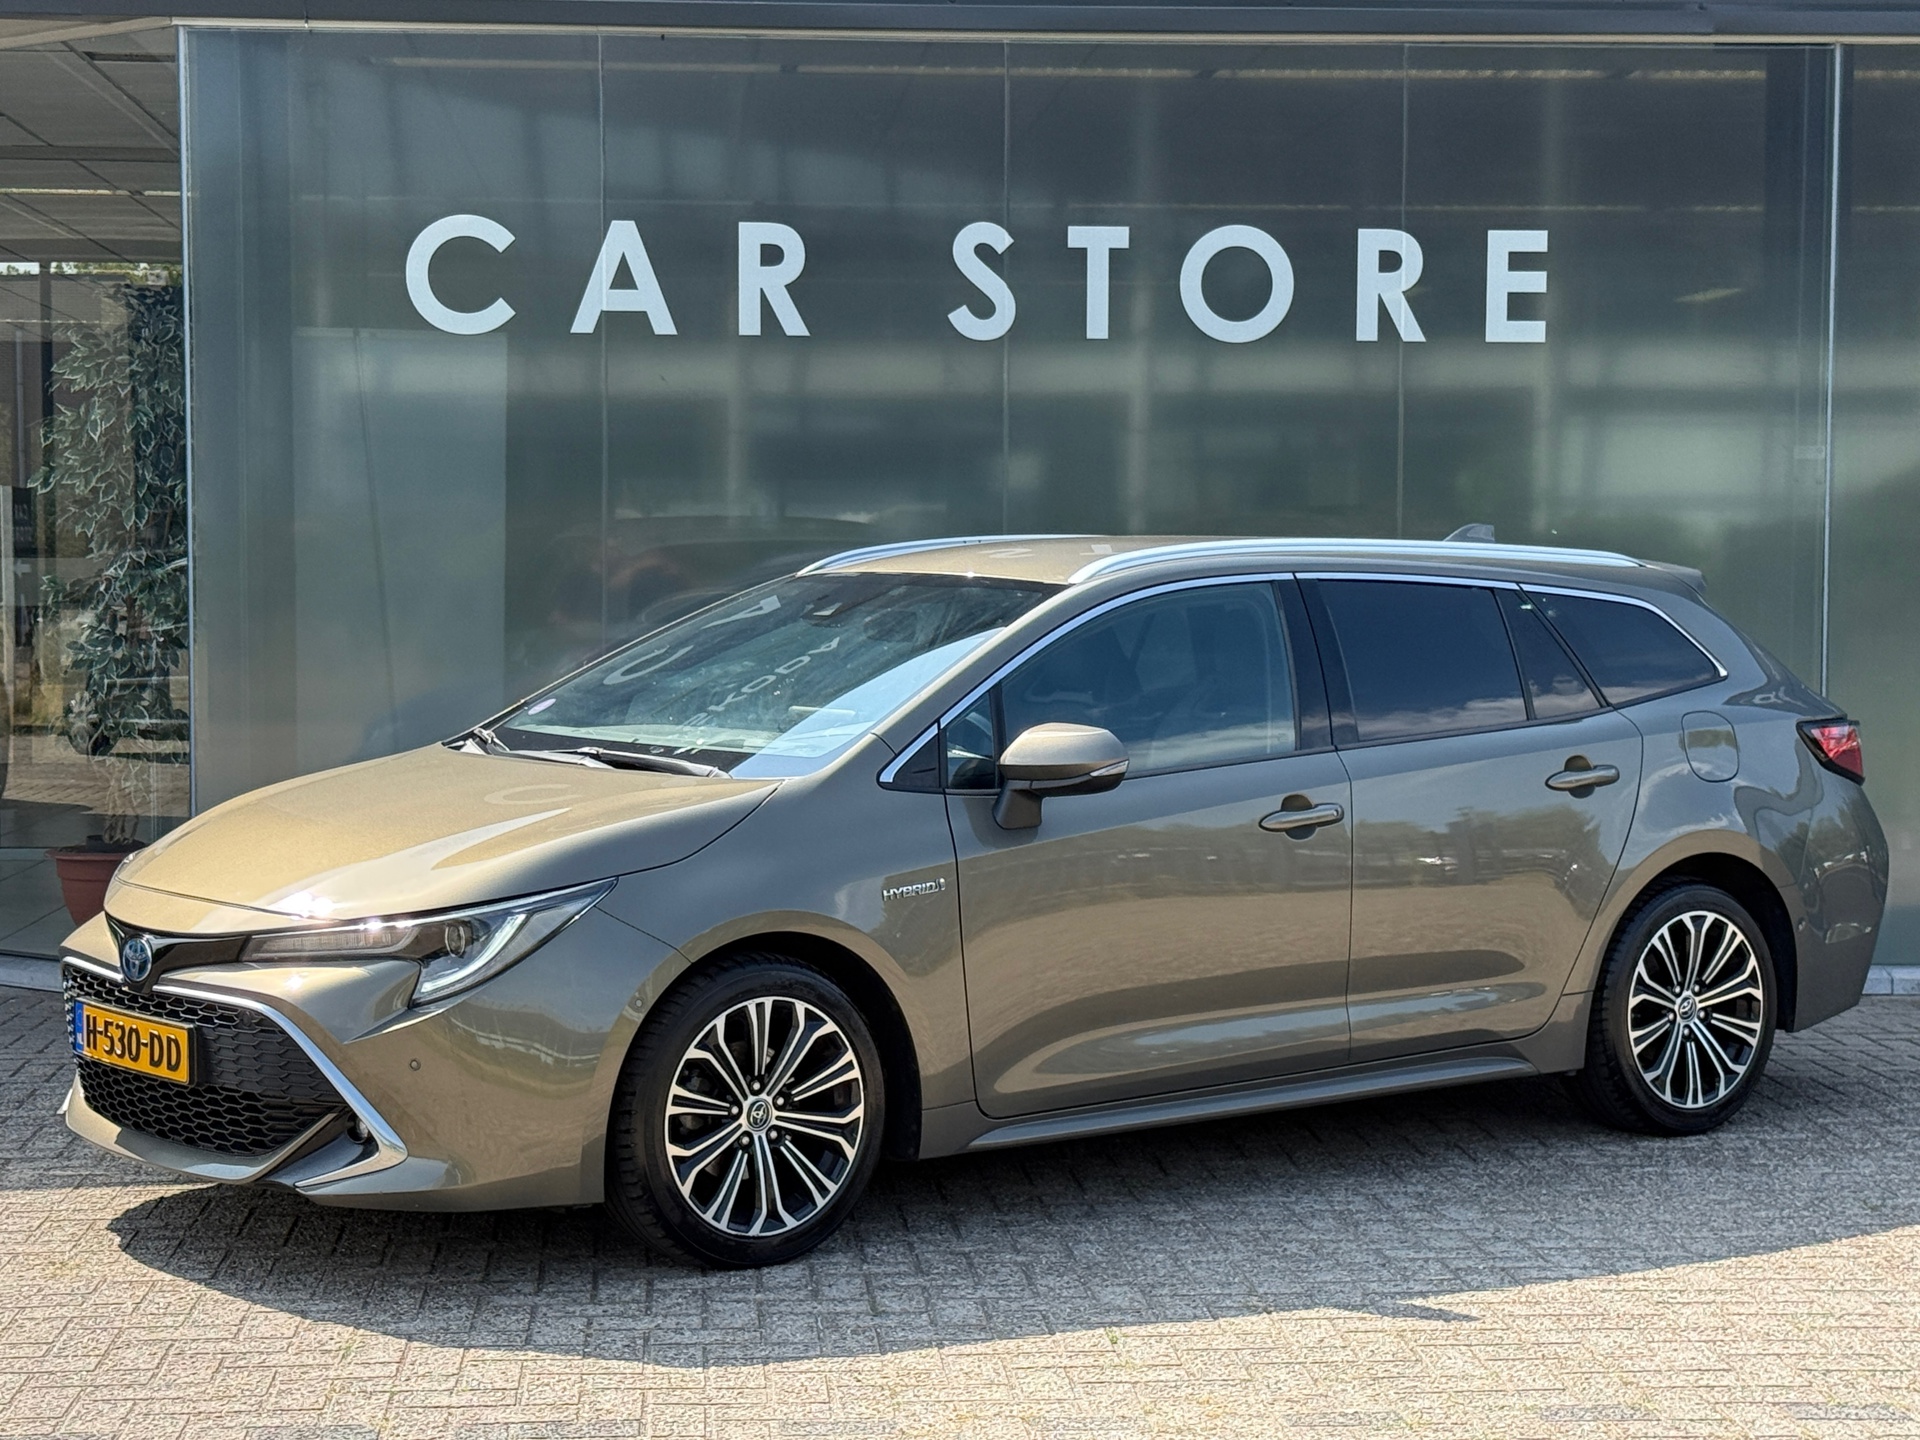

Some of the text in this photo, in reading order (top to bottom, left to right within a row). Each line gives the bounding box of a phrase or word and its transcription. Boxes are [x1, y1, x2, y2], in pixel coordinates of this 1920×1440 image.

[405, 214, 1549, 344] CAR STORE
[882, 880, 939, 901] HYBRID
[85, 1014, 182, 1073] H-530-DD
